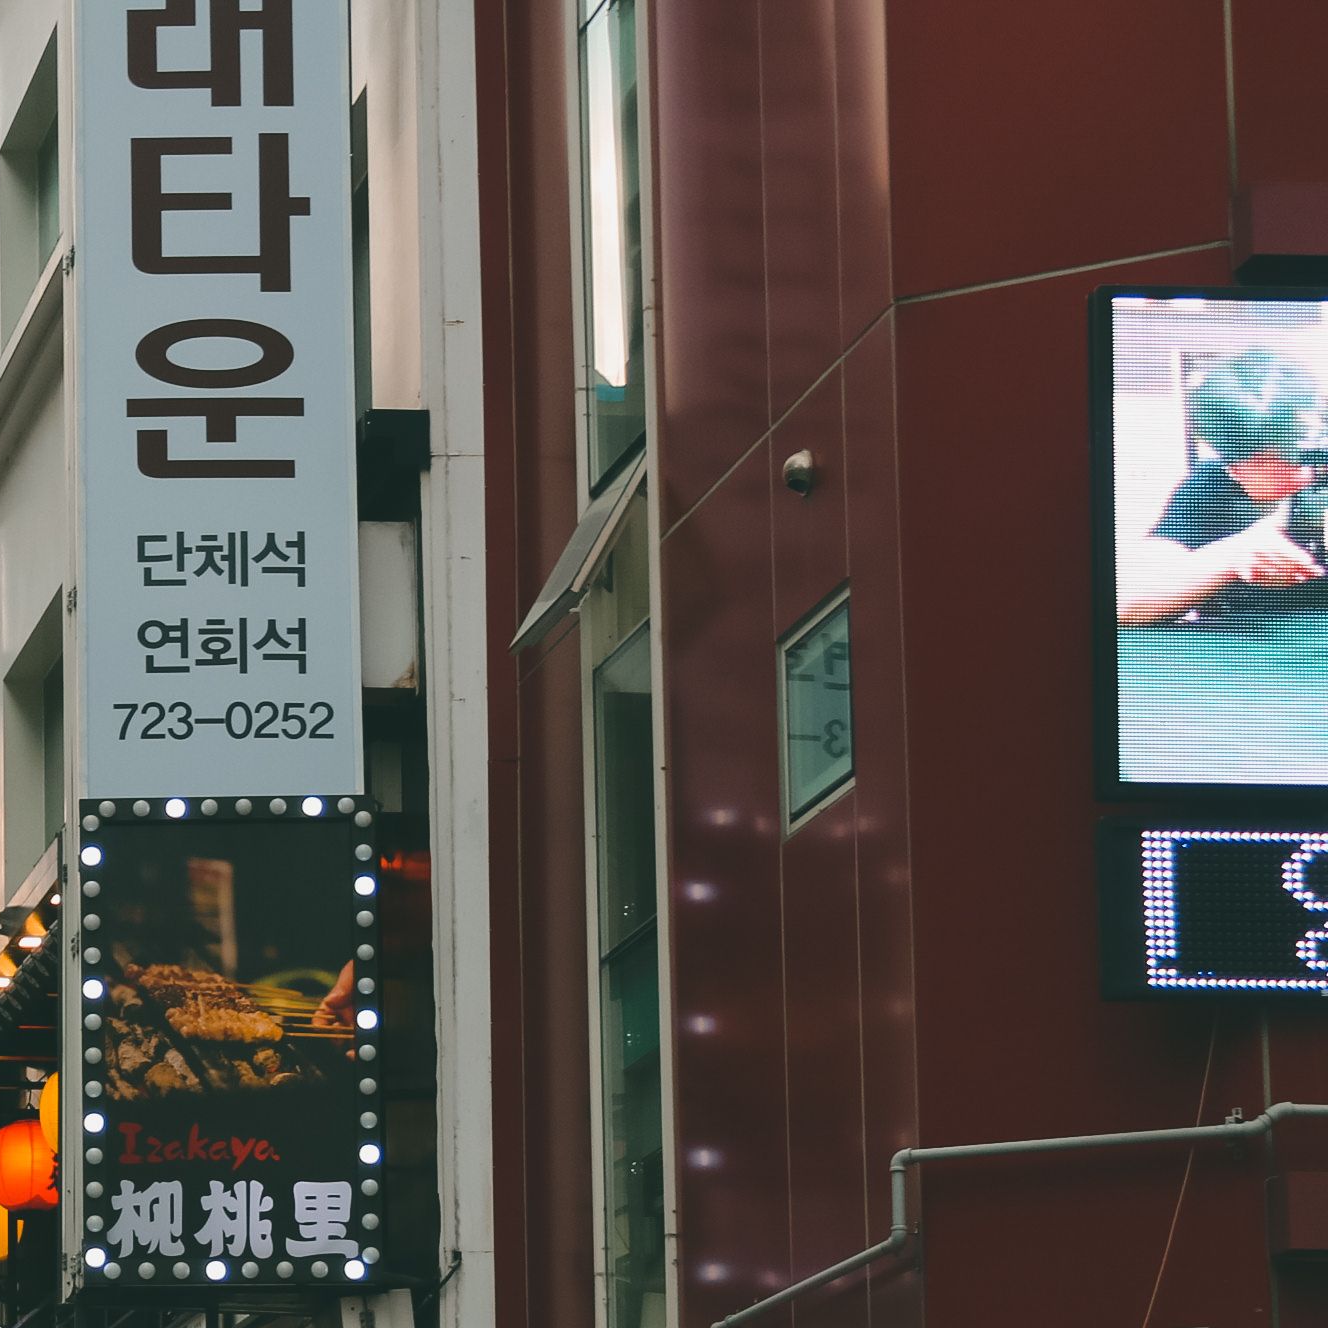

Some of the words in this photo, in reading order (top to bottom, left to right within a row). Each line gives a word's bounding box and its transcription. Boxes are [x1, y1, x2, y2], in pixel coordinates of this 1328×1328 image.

[137, 530, 307, 588] 단체석
[137, 617, 307, 674] 연회석
[113, 702, 335, 741] 723-0252
[118, 1121, 280, 1173] Izakaya
